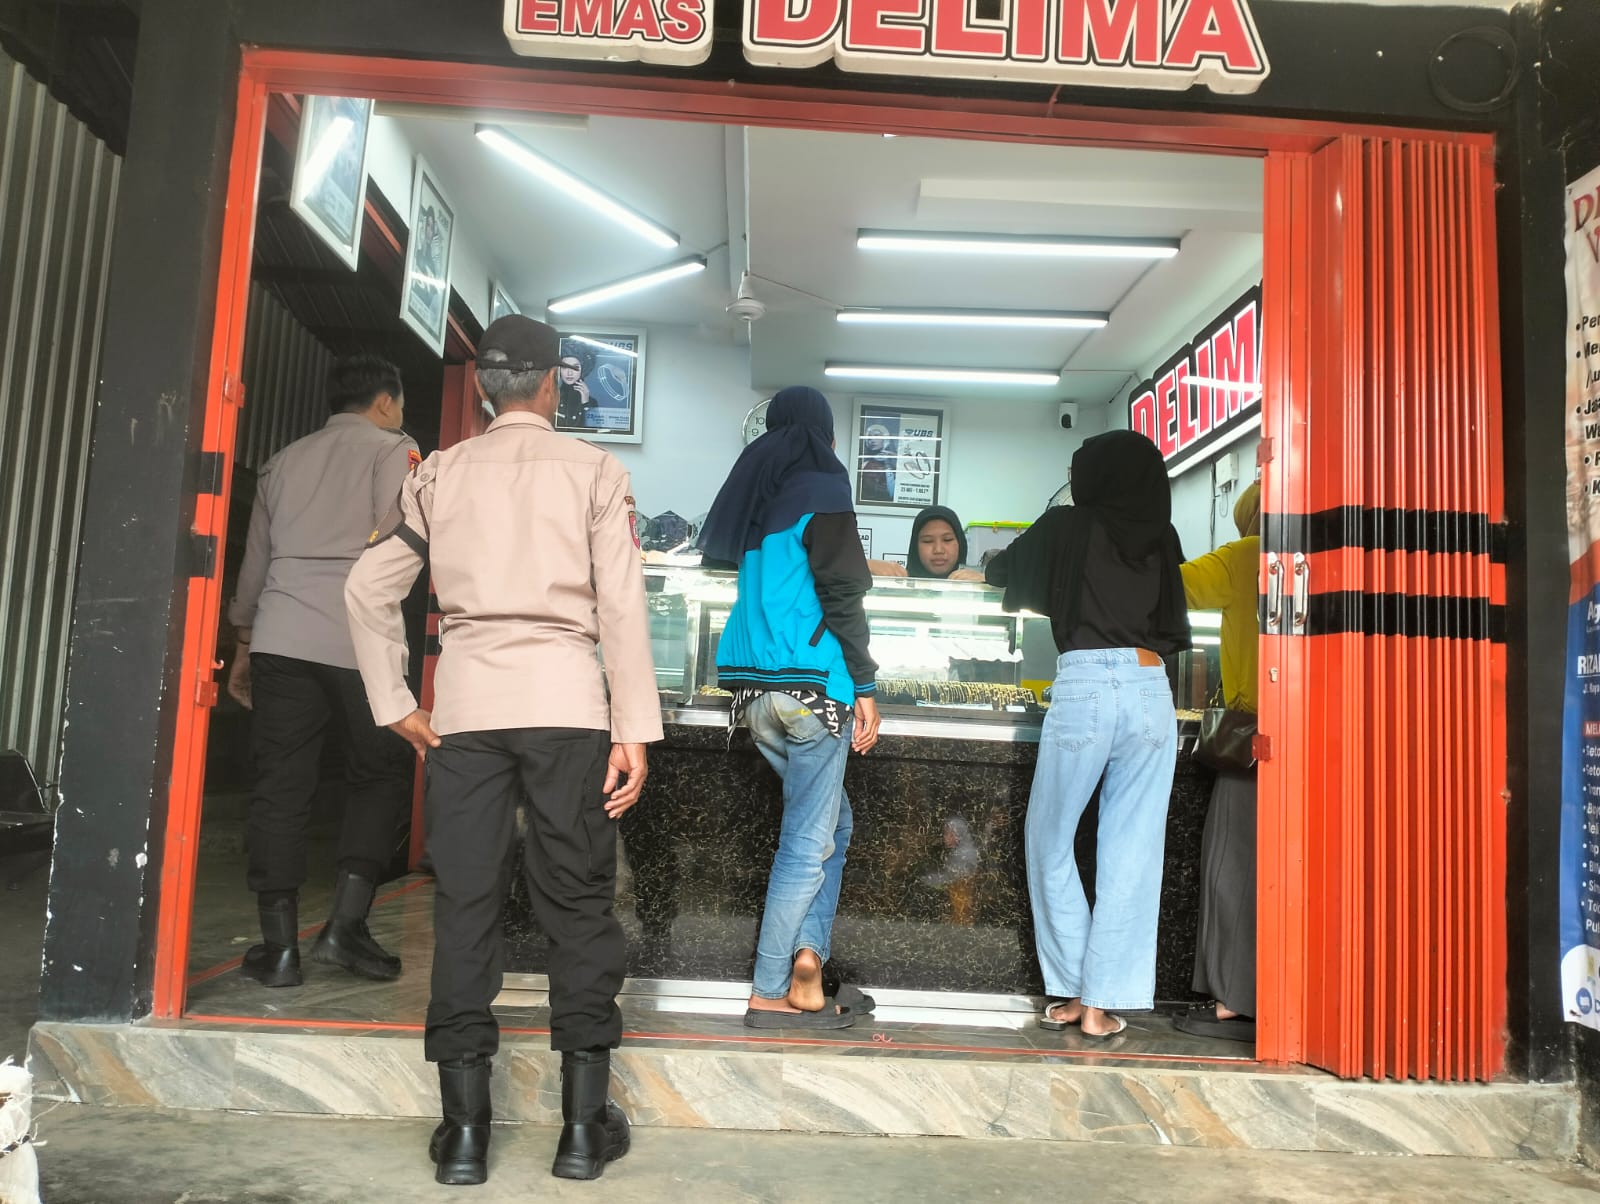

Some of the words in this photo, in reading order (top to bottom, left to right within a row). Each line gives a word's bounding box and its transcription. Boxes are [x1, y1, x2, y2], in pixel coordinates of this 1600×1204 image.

[517, 0, 705, 42] EMAS
[1131, 300, 1263, 461] DELIM
[751, 428, 759, 436] 9
[914, 429, 933, 437] UBS
